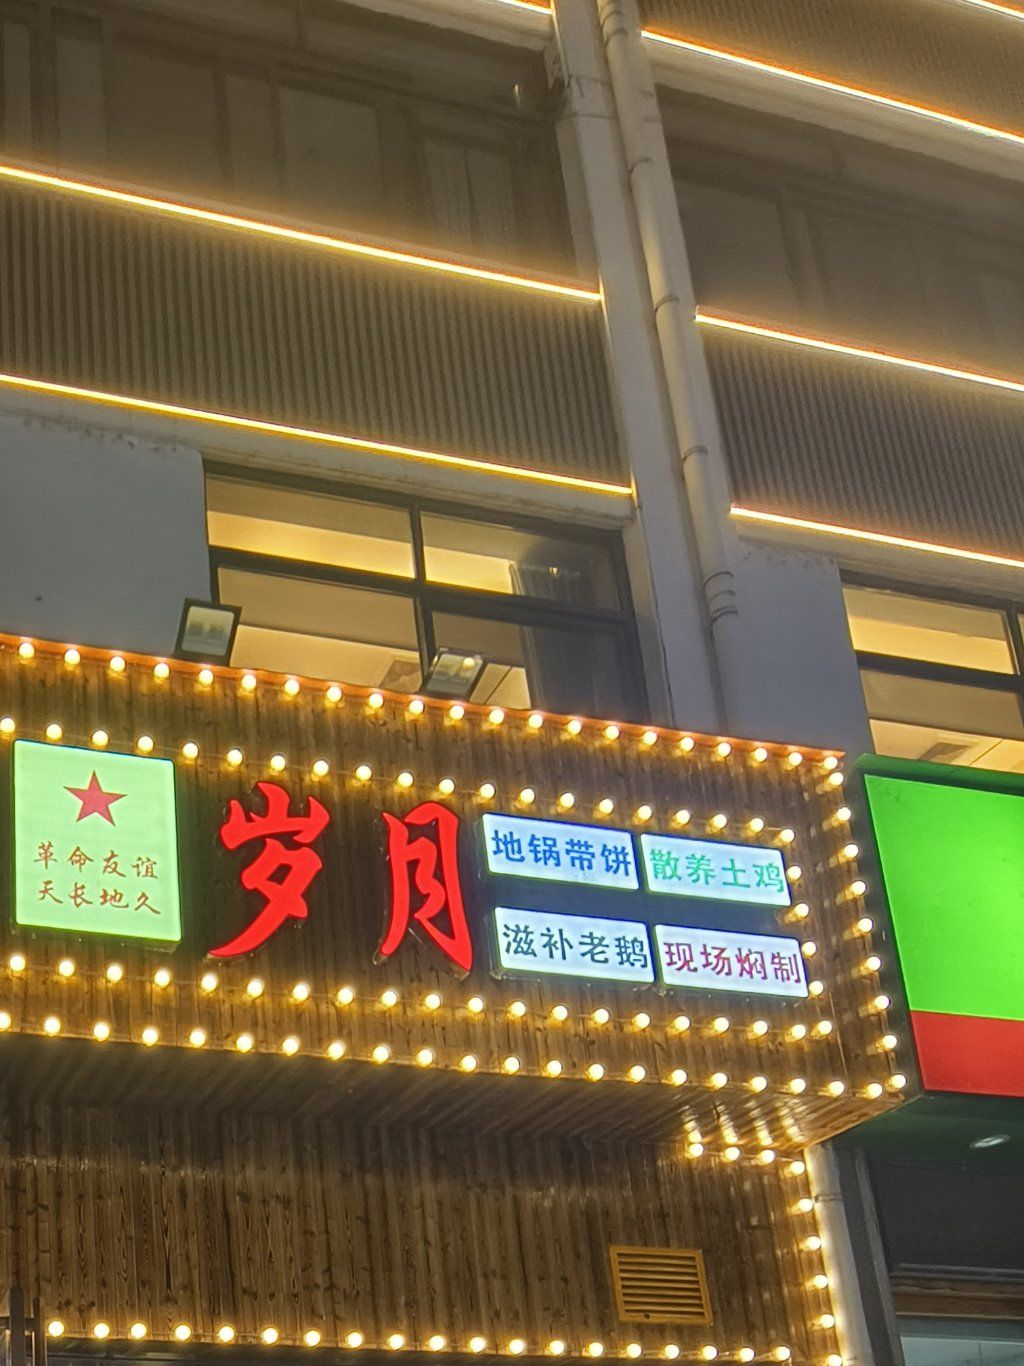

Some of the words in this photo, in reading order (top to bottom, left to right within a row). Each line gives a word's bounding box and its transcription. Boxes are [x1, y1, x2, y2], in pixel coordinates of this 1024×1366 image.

[33, 841, 158, 879] 革命友谊
[491, 830, 632, 877] 地锅带饼
[650, 848, 785, 894] 散养土鸡
[39, 880, 161, 915] 天长地久
[502, 923, 649, 969] 滋补老鹅
[663, 941, 802, 984] 现场焖制
